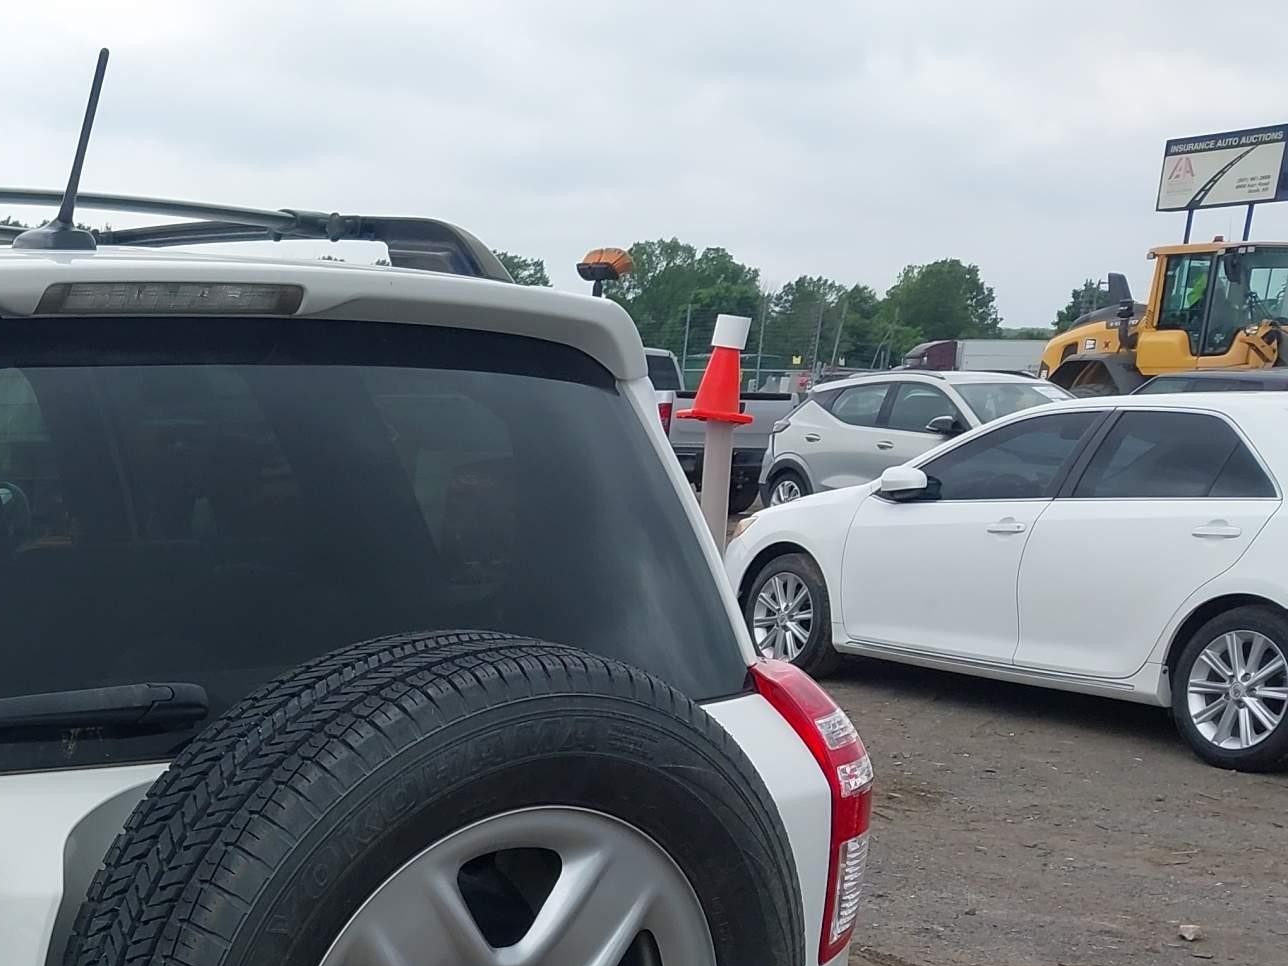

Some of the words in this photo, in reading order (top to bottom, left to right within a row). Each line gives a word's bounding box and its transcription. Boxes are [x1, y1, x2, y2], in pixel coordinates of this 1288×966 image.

[1170, 139, 1216, 153] INSURANCE
[1216, 137, 1239, 148] AUTO
[1240, 131, 1284, 145] AUCTIONS
